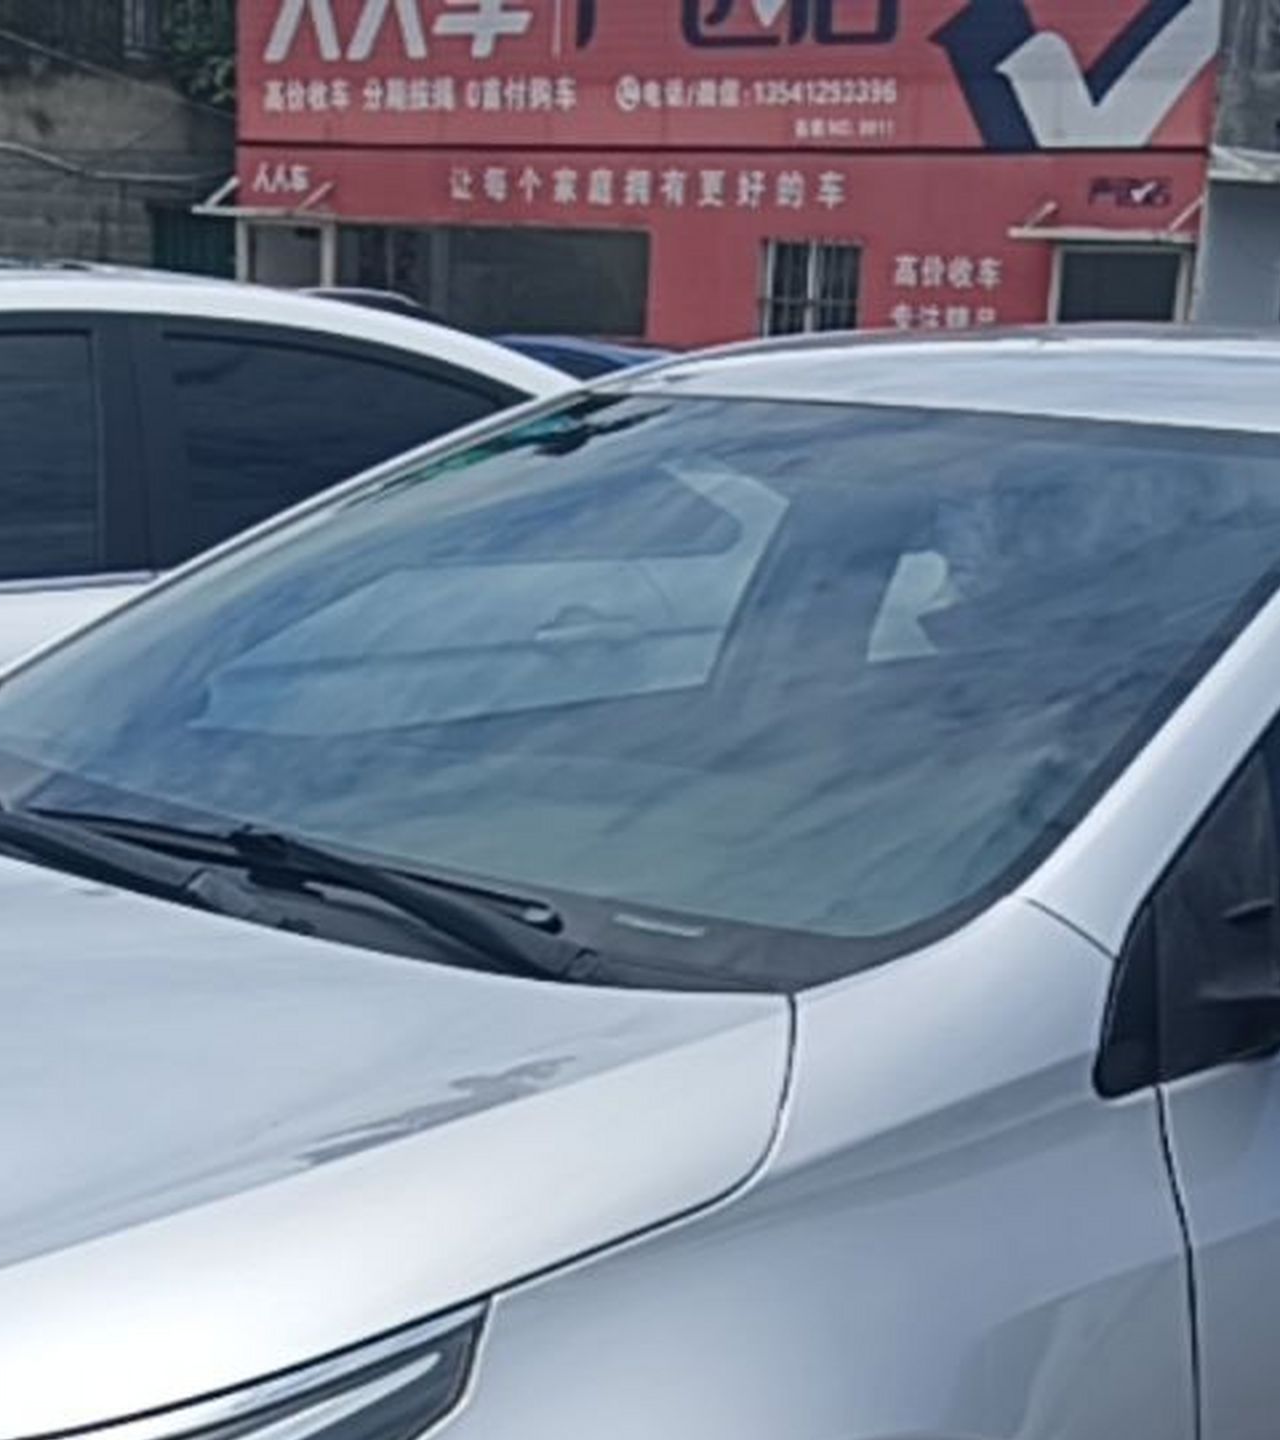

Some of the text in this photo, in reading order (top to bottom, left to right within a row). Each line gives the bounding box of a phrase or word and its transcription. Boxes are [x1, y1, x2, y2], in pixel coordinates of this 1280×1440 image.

[263, 79, 350, 112] 高价收车
[893, 255, 1004, 290] 高价收车
